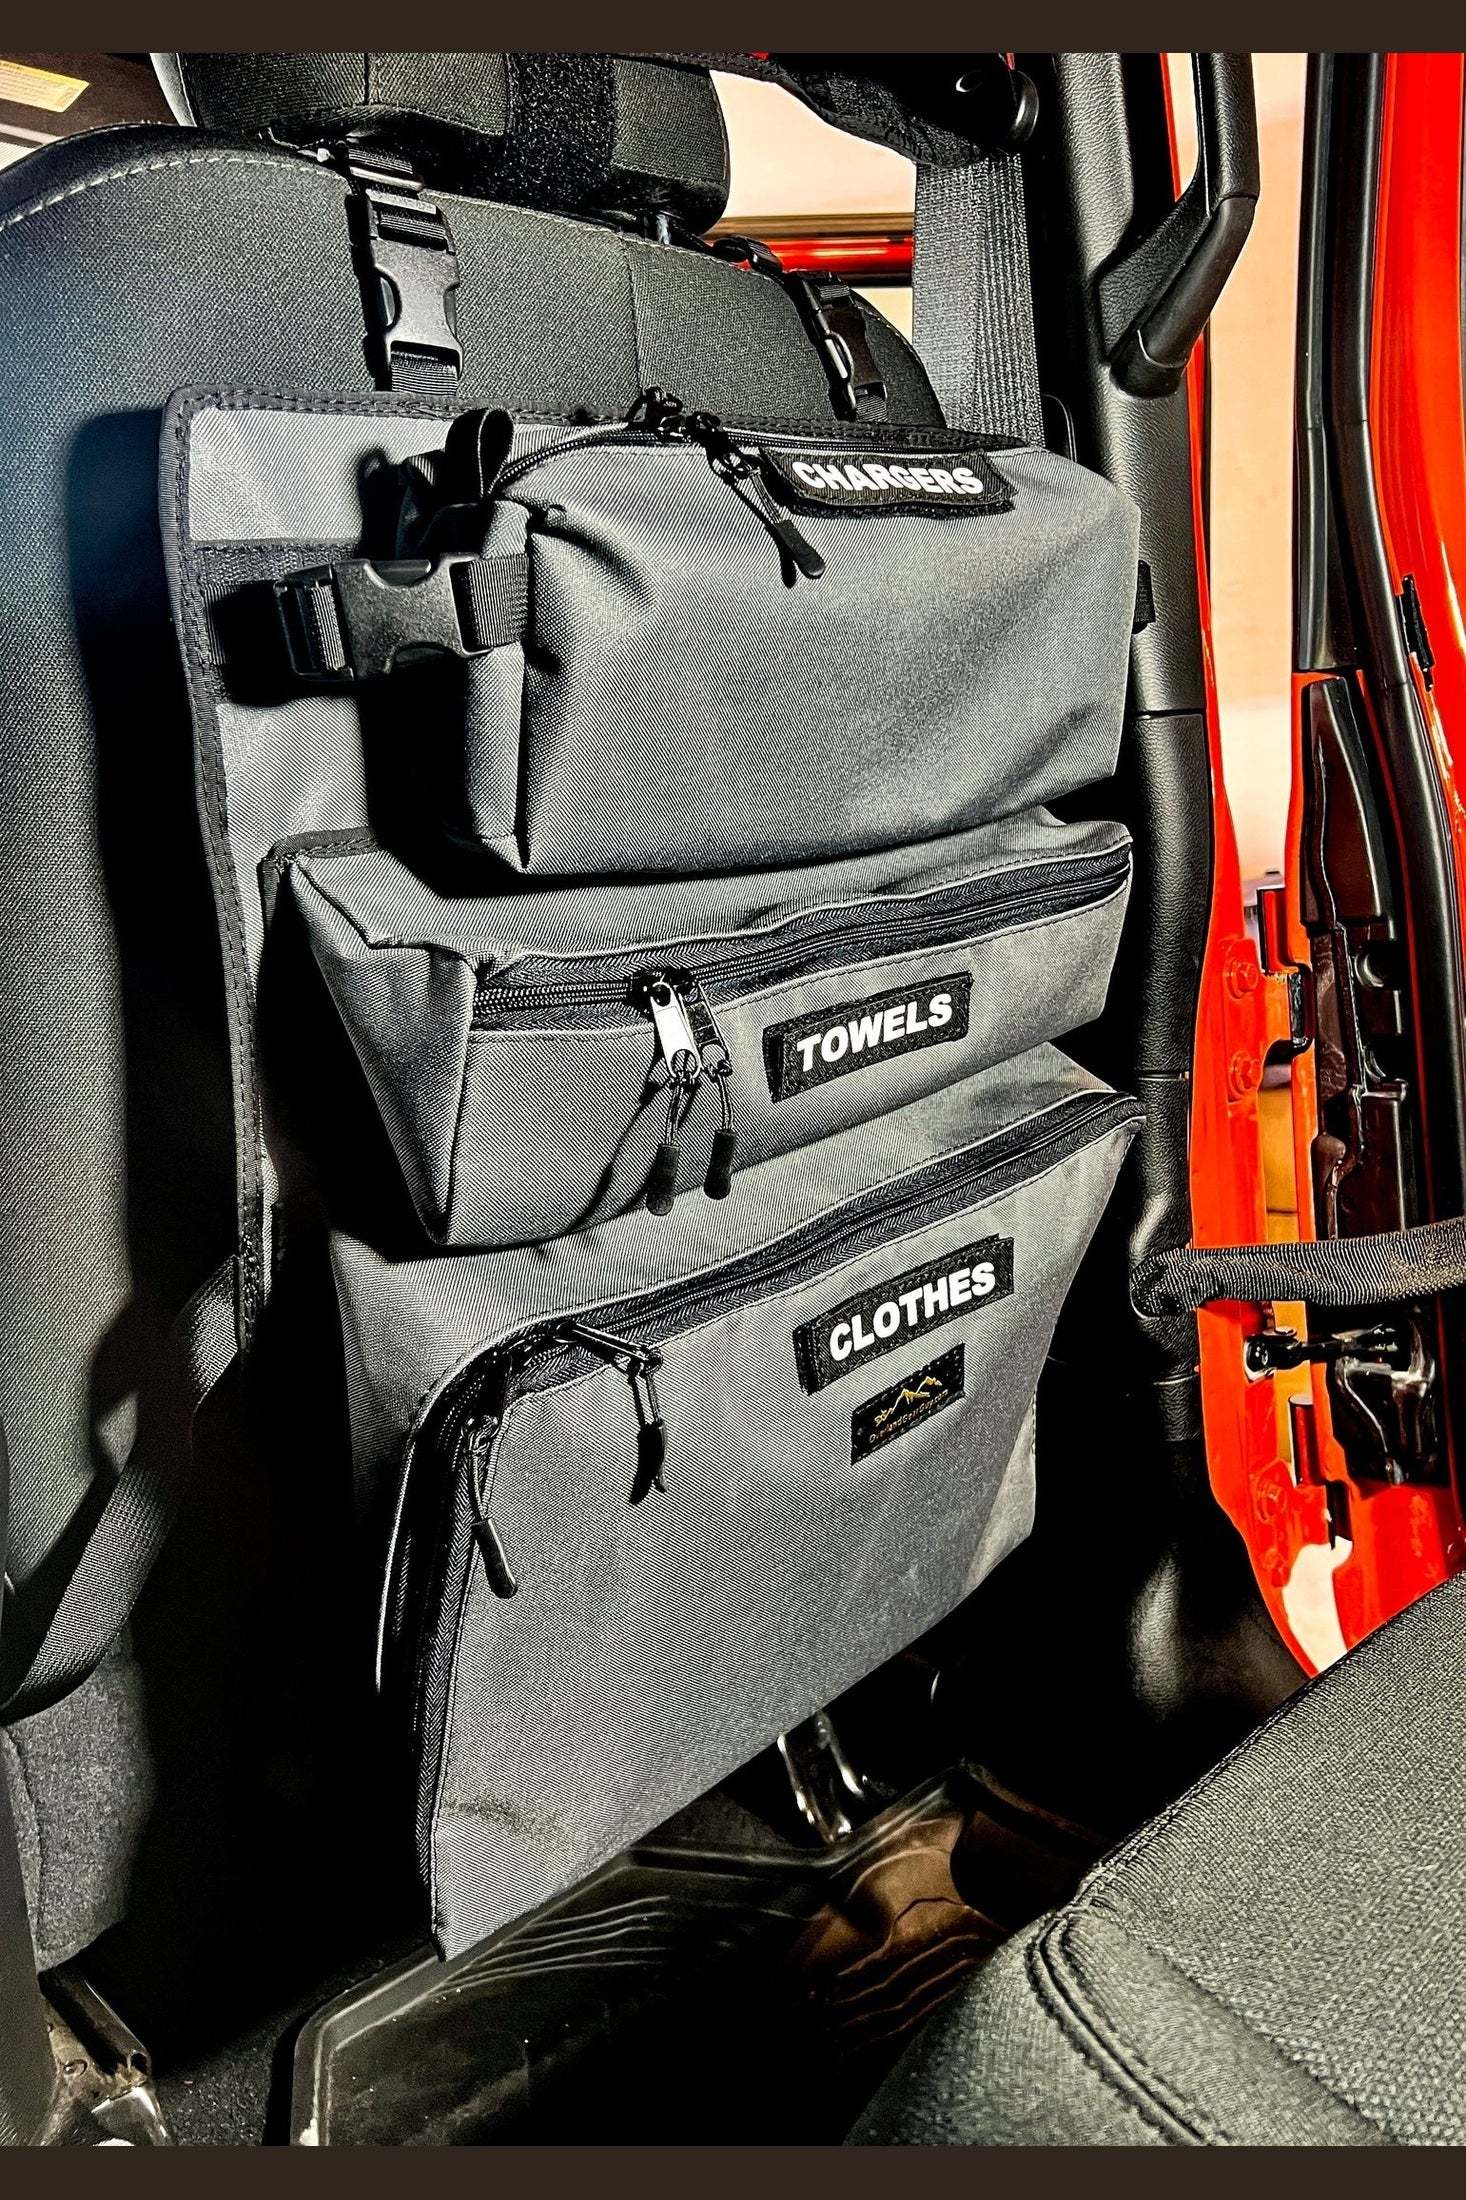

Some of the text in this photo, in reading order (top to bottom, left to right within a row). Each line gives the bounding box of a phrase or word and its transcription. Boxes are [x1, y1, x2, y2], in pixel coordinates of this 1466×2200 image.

[792, 461, 984, 495] CHARGERS
[797, 993, 953, 1072] TOWELS
[829, 1262, 996, 1361] CLOTHES
